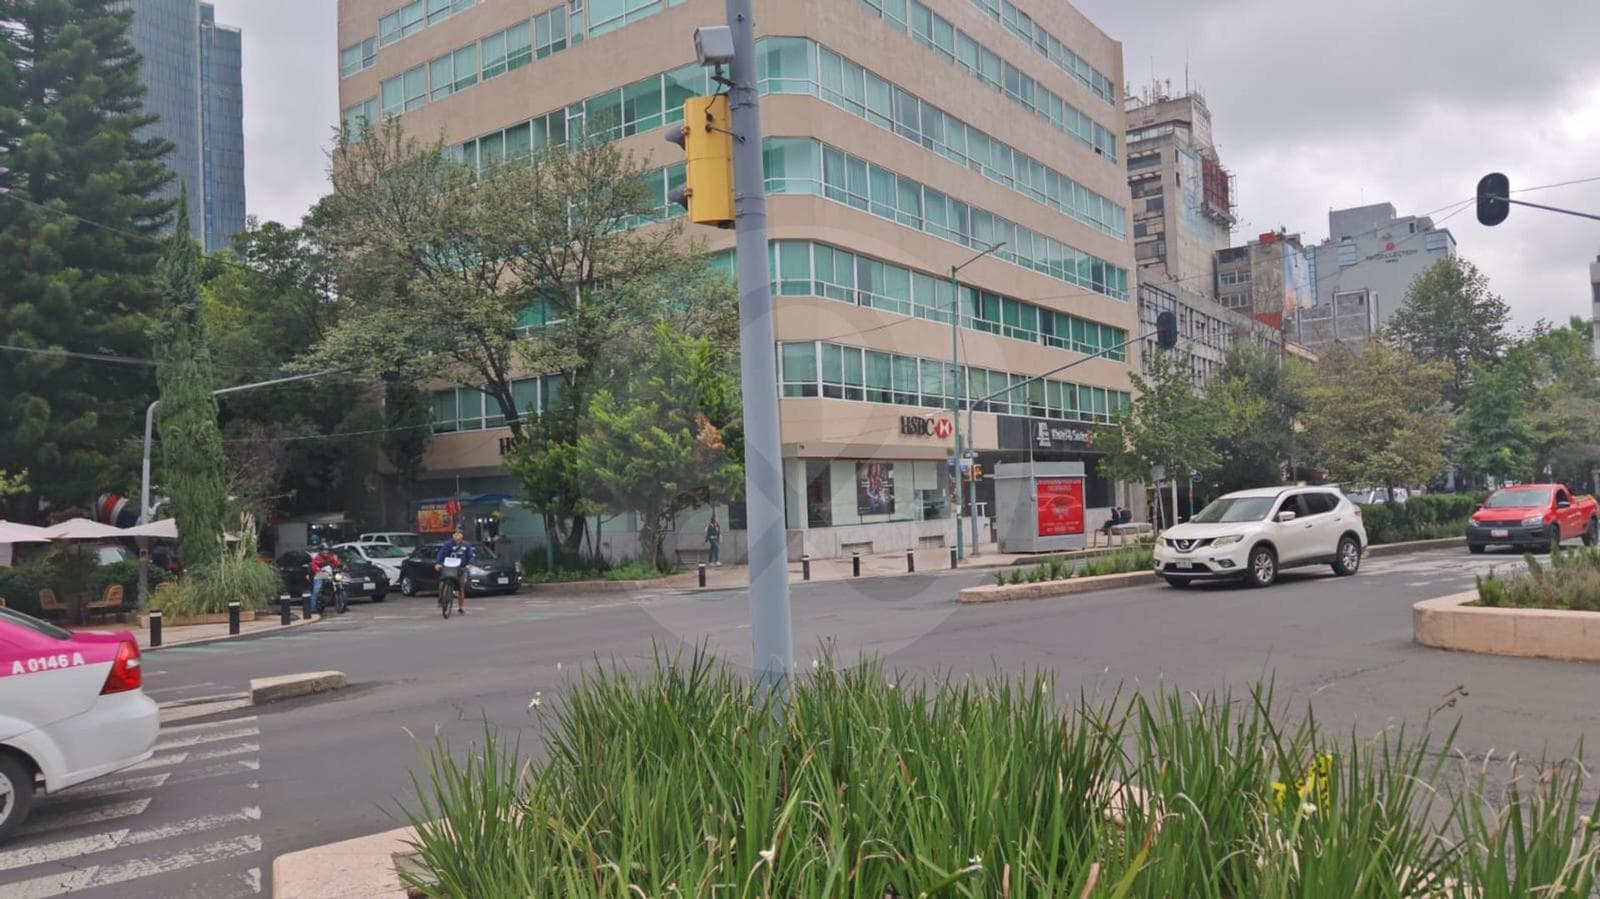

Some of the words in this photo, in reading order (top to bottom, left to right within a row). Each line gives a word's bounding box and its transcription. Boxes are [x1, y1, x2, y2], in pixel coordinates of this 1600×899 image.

[900, 416, 935, 436] HSBC
[12, 661, 25, 674] A
[28, 654, 69, 672] 0146
[73, 652, 84, 666] A
